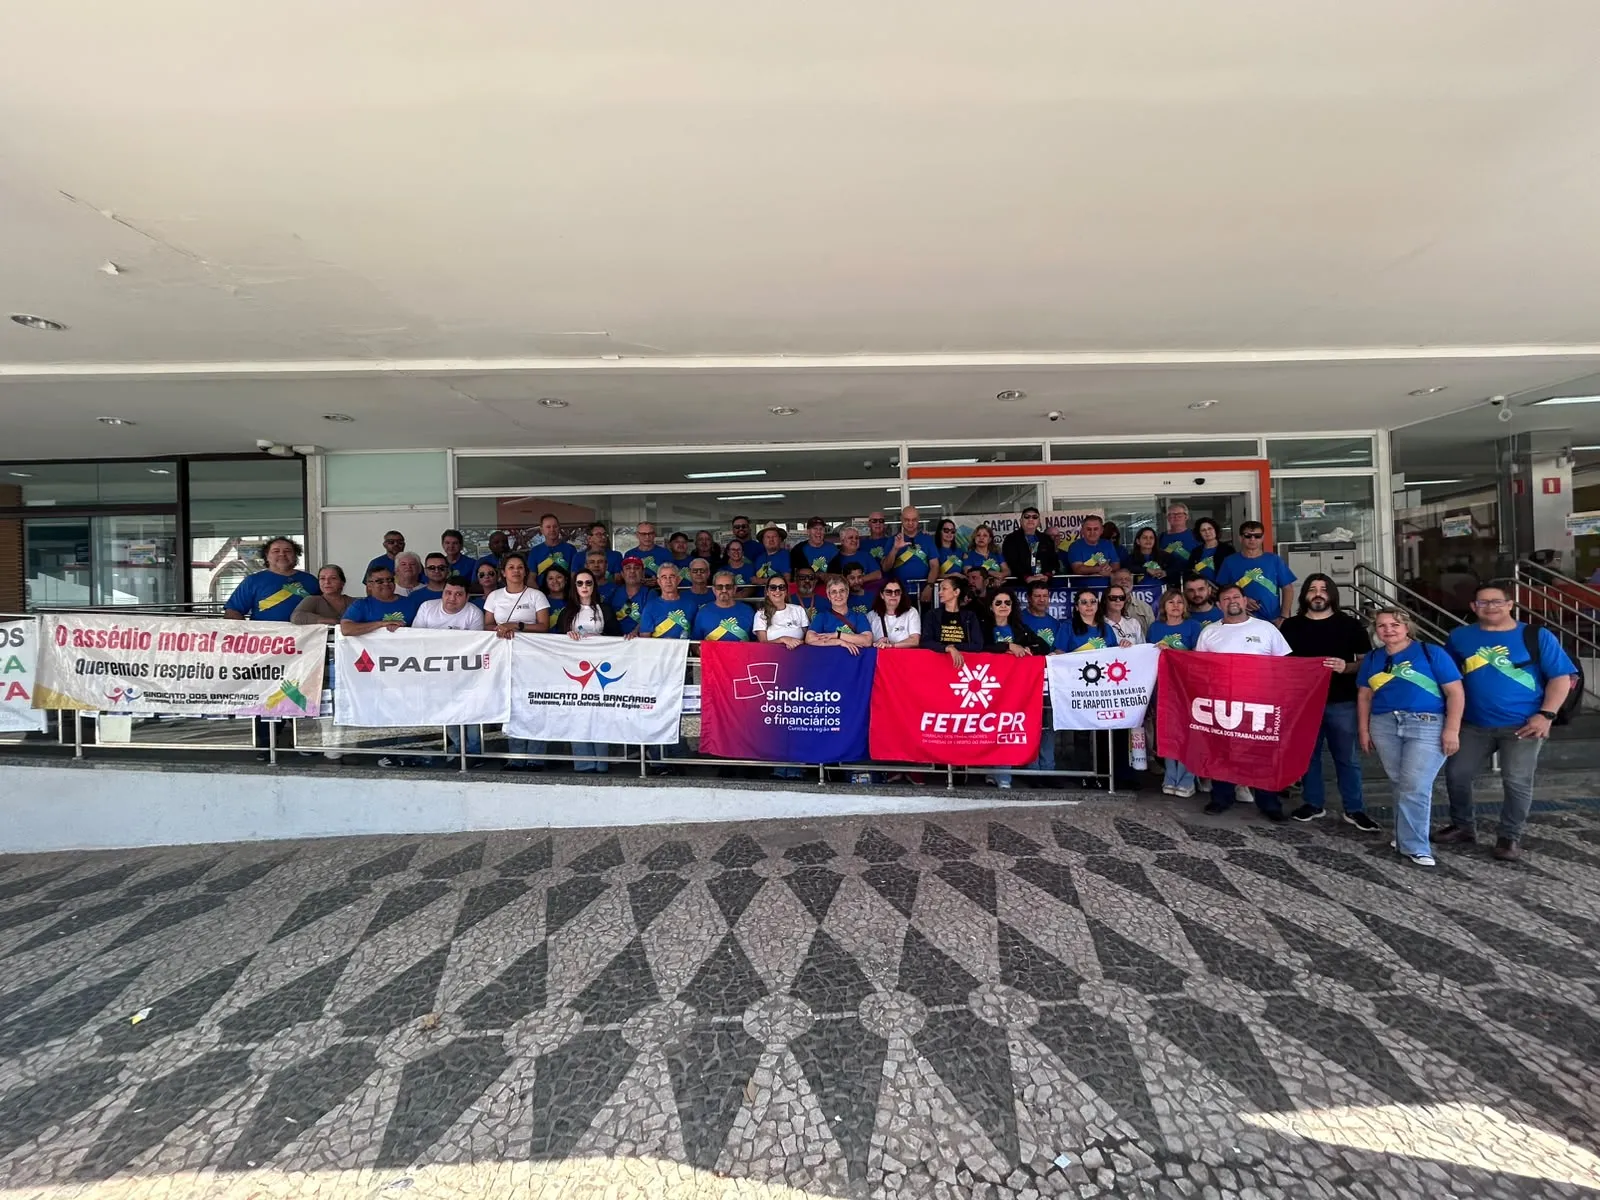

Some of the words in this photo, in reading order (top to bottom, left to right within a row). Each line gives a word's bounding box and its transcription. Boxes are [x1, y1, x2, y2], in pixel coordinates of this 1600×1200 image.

[1045, 514, 1088, 528] NACION
[55, 624, 68, 647] O
[72, 625, 152, 651] assédio
[157, 631, 218, 652] moral
[221, 632, 303, 655] adoece.
[0, 655, 26, 673] A
[75, 658, 149, 677] Queremos
[153, 662, 214, 681] respeito
[219, 666, 228, 680] e
[232, 663, 285, 681] saúde!
[378, 654, 482, 672] PACTU
[143, 691, 186, 699] SINDICATO
[527, 691, 578, 700] SINDICATO
[581, 693, 600, 701] DOS
[603, 693, 657, 704] BANCÁRIOS
[766, 686, 842, 702] sindicato
[1071, 690, 1099, 698] SINDICATO
[1100, 689, 1112, 697] DOS
[1113, 687, 1147, 696] BANCÁRIOS
[760, 702, 782, 713] dos
[784, 702, 841, 714] bancários
[1071, 699, 1082, 709] DE
[1083, 698, 1113, 709] ARAPOTI
[1114, 698, 1119, 708] E
[1120, 694, 1148, 708] REGIÃO
[764, 716, 772, 725] e
[774, 713, 841, 726] financiários
[1097, 711, 1124, 720] CUT
[1191, 697, 1274, 732] CUT
[997, 733, 1027, 744] CUT
[1189, 723, 1211, 733] CENTRAL
[1235, 732, 1280, 742] TRABALHADORES
